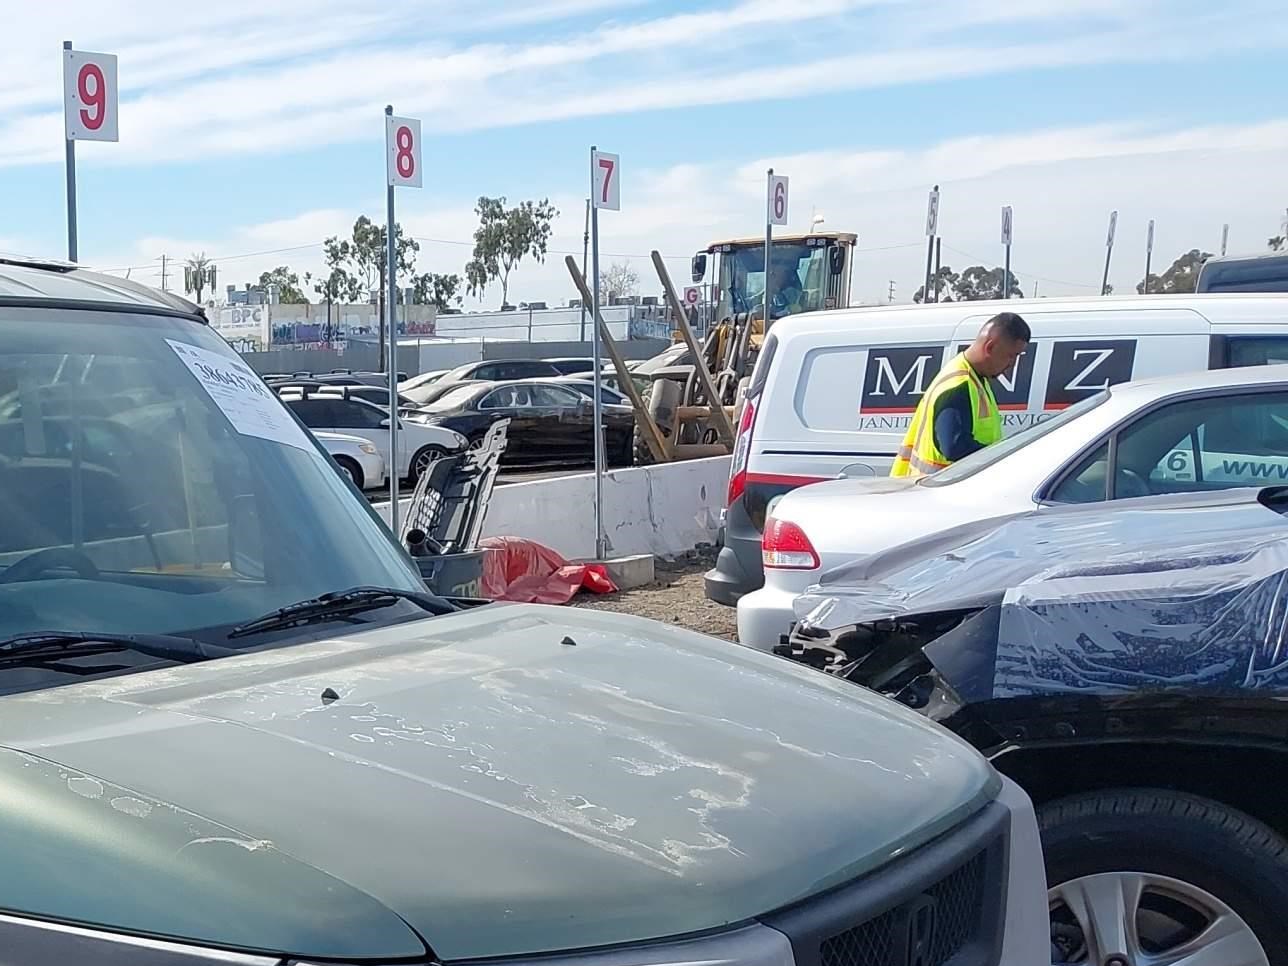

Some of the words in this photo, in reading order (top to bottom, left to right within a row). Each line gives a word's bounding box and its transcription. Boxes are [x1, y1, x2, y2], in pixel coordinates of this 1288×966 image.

[78, 63, 106, 131] 9
[396, 126, 415, 179] 8
[598, 159, 614, 203] 7
[774, 182, 785, 219] 6
[928, 196, 938, 230] 5
[1003, 211, 1011, 241] 4
[686, 288, 699, 304] G
[1167, 451, 1187, 472] 6
